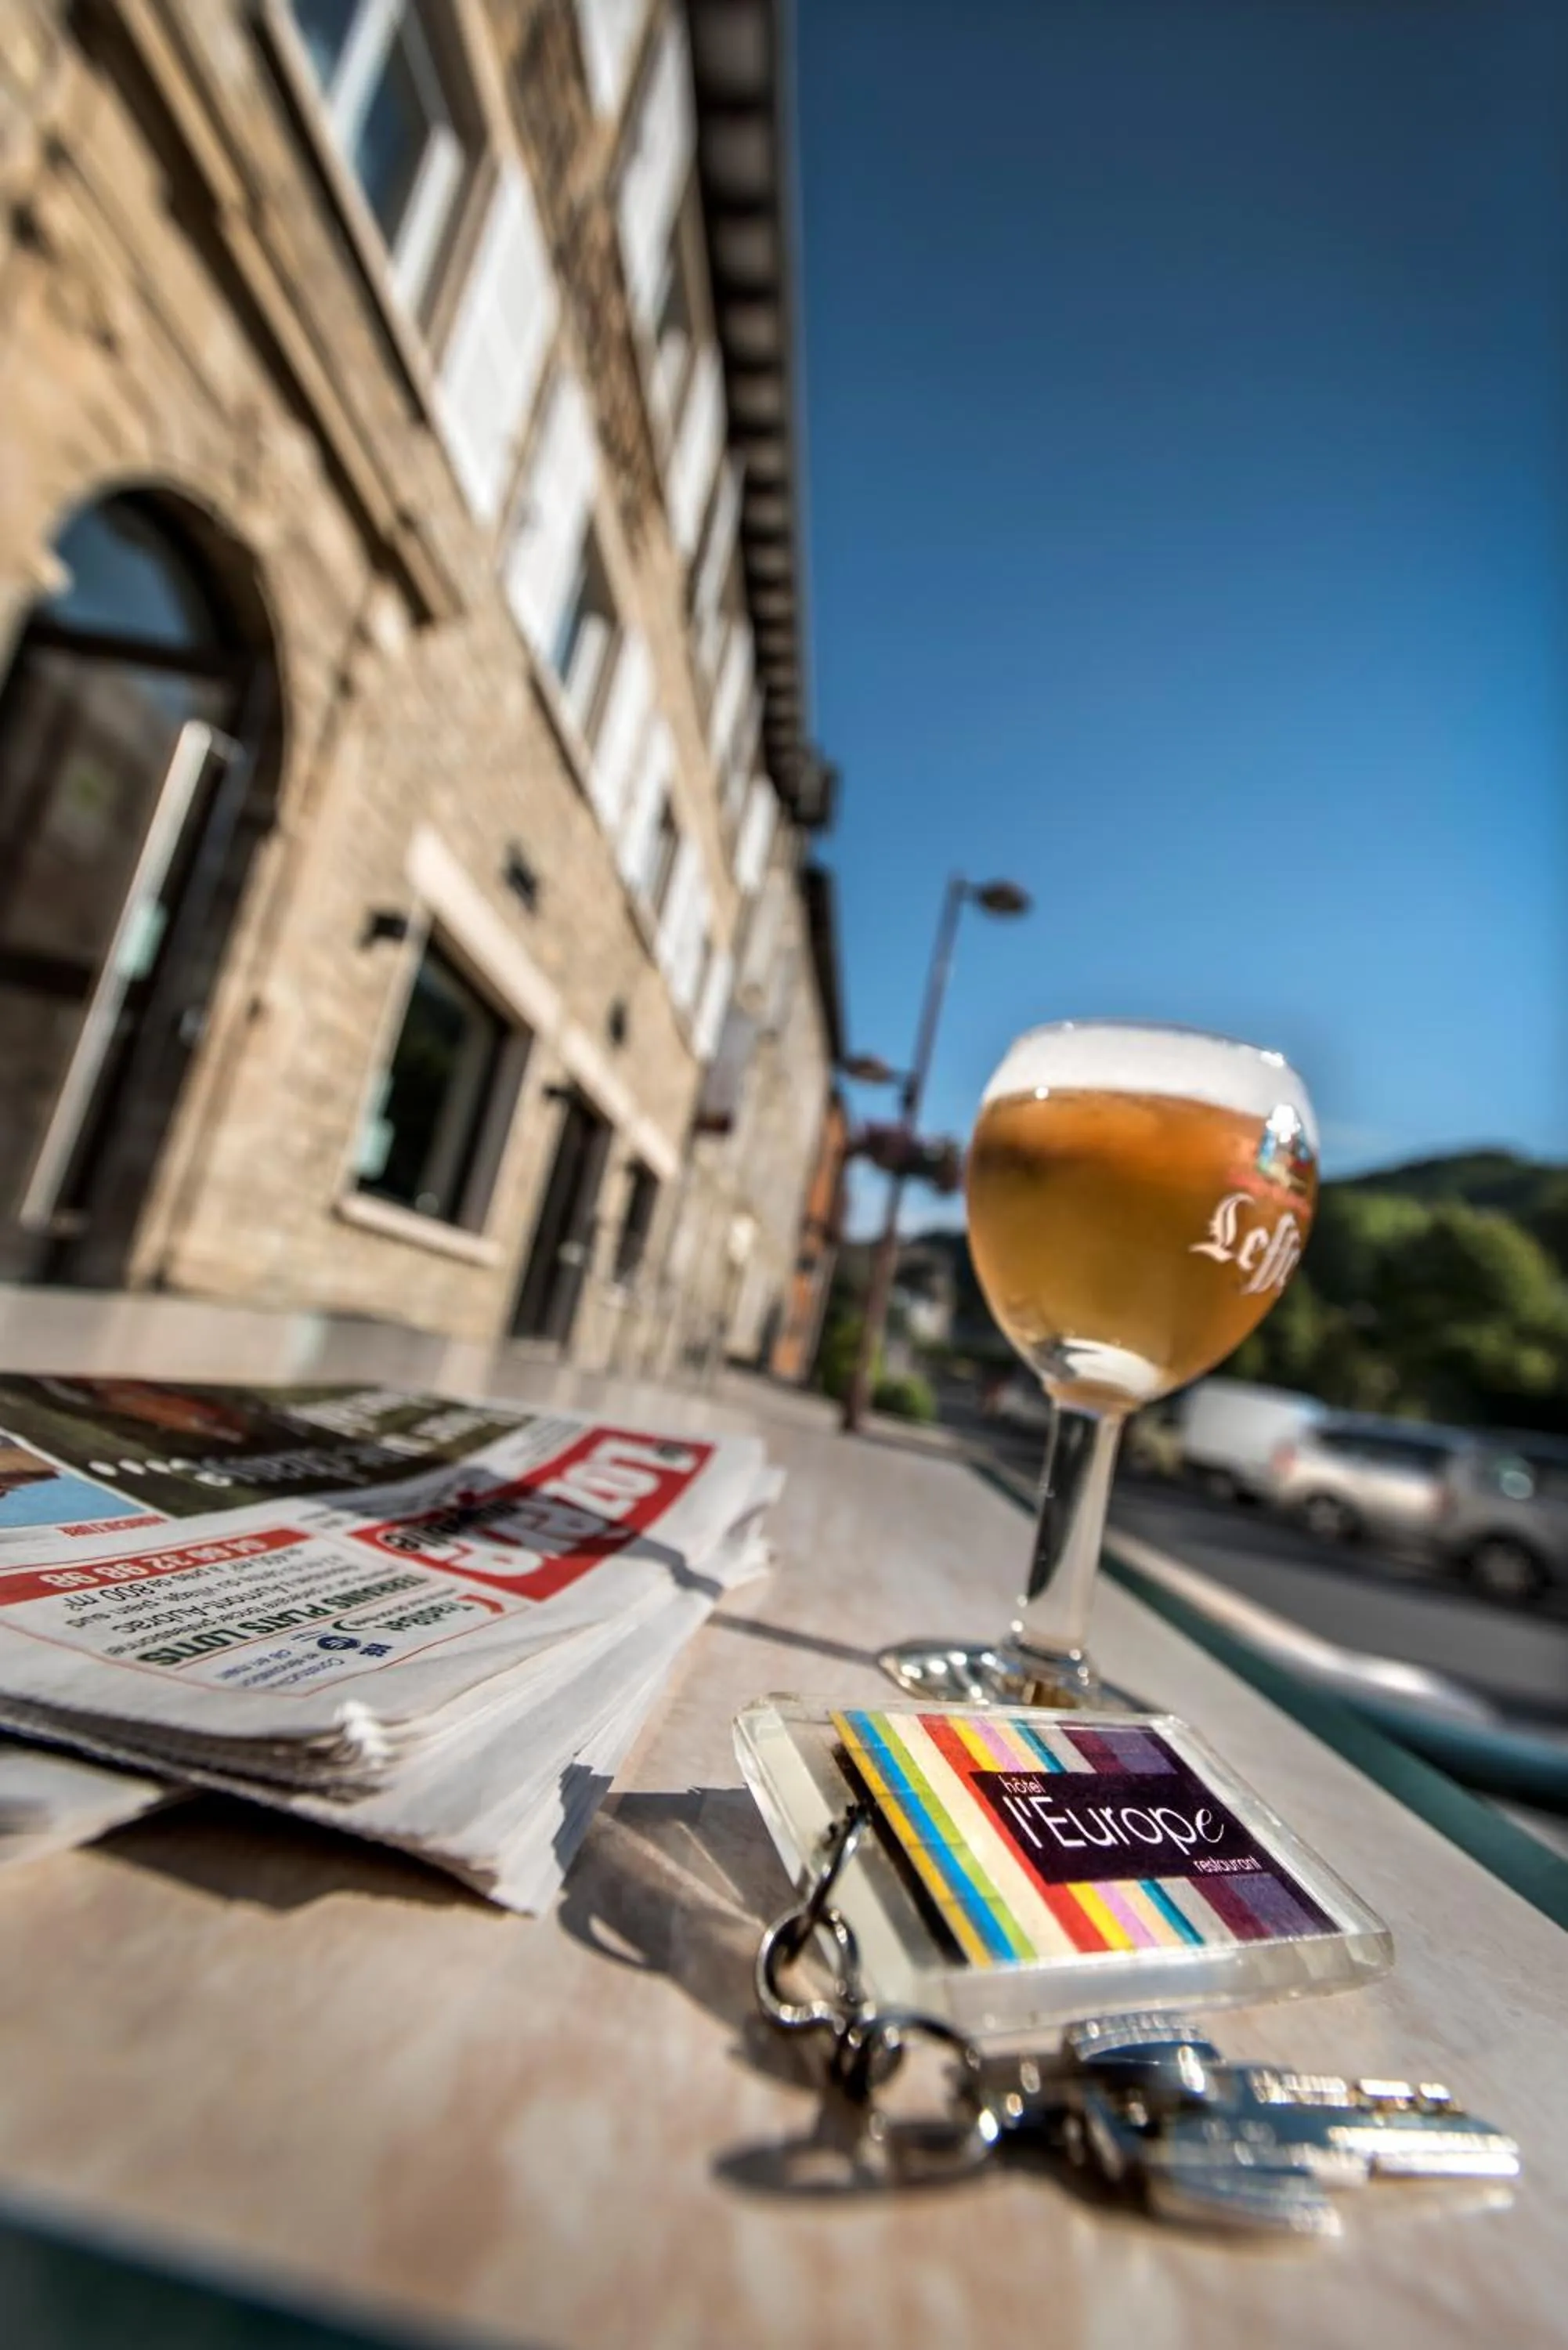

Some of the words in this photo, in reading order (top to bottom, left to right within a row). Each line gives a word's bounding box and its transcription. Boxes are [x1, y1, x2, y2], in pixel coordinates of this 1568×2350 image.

[92, 1564, 149, 1579] 98
[141, 1554, 192, 1570] 32
[39, 1571, 99, 1588] 98
[99, 1584, 155, 1603] 800
[321, 1574, 428, 1609] TERRAINS
[112, 1585, 288, 1634] Aumont-Aubrac
[238, 1604, 333, 1633] PLATS
[136, 1629, 251, 1666] LOTIS
[999, 1775, 1046, 1795] hôtel
[1003, 1796, 1223, 1856] l'Europe
[1193, 1856, 1263, 1874] restaurant
